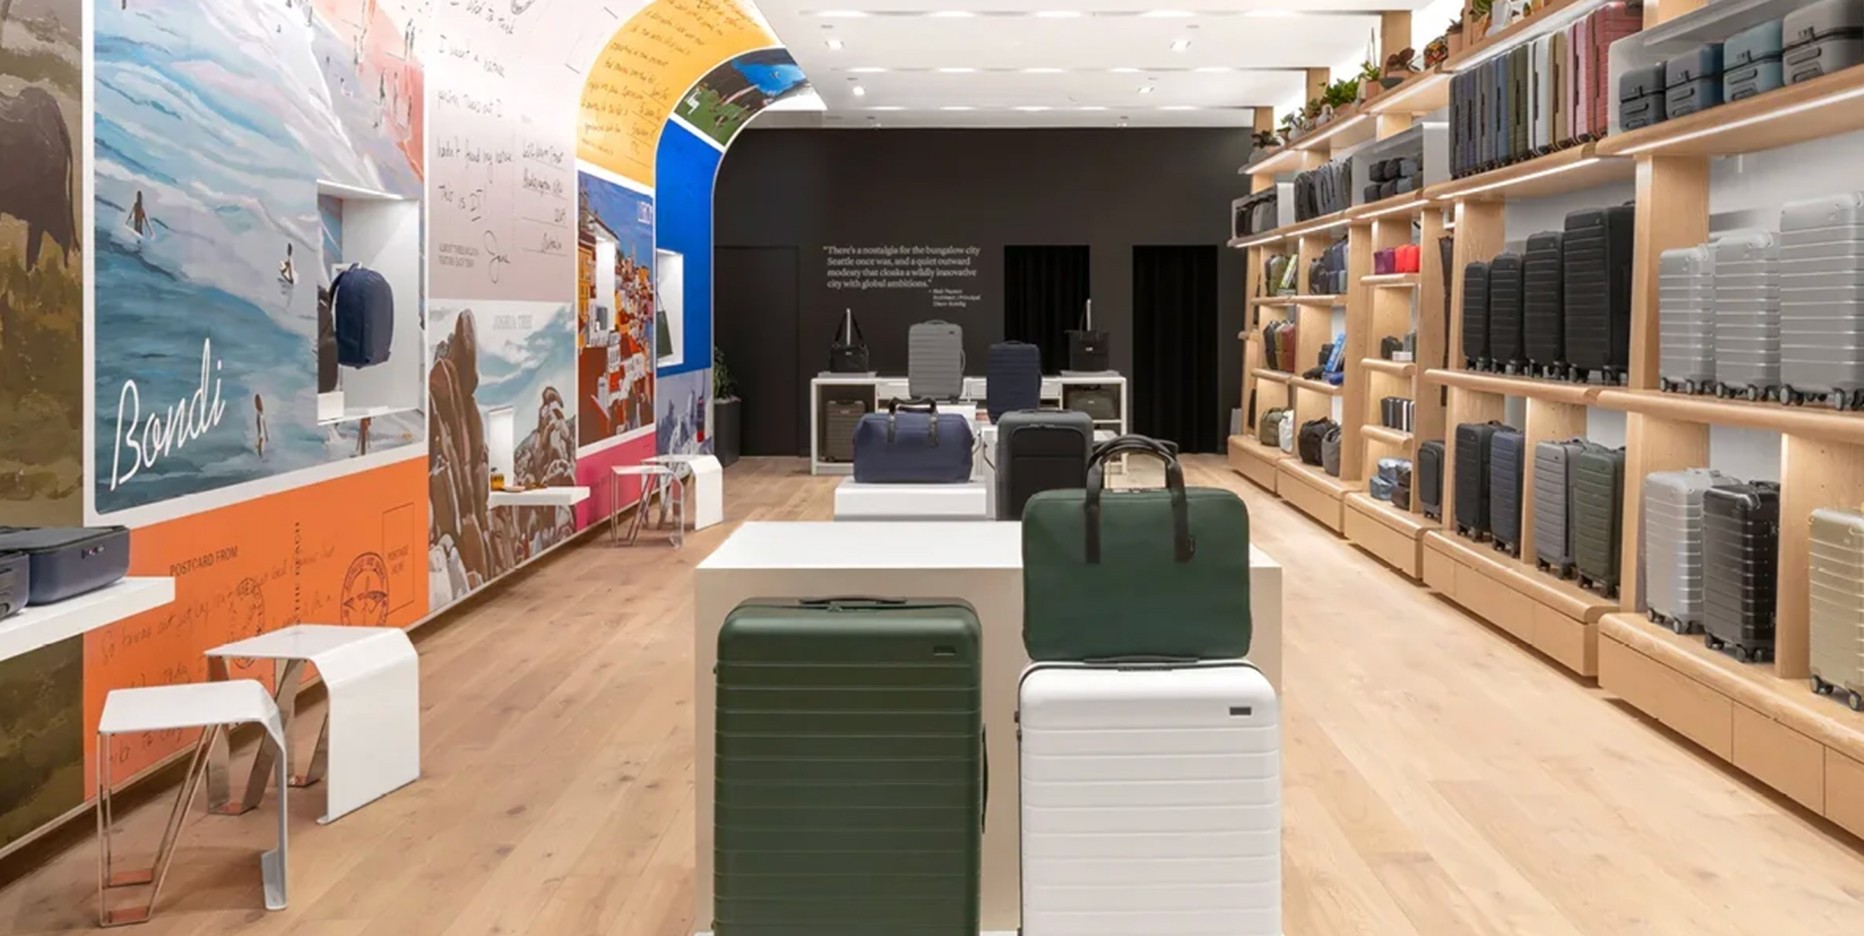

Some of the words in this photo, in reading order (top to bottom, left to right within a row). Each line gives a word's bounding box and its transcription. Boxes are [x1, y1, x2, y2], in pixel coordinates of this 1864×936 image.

[863, 246, 898, 257] nostalgia
[899, 246, 911, 255] for
[912, 246, 925, 255] the
[925, 246, 964, 257] bungalow
[965, 246, 981, 257] city
[827, 257, 854, 266] Seattle
[895, 257, 910, 266] and
[916, 257, 937, 268] quiet
[938, 257, 971, 266] outward
[827, 268, 861, 279] modesty
[862, 268, 878, 277] that
[879, 268, 904, 277] cloaks
[911, 268, 935, 279] wildly
[936, 268, 977, 277] innovative
[827, 279, 842, 289] city
[843, 279, 860, 288] with
[861, 279, 886, 290] global
[110, 337, 226, 492] Bondi
[169, 553, 214, 577] POSTCARD
[215, 546, 239, 562] FROM
